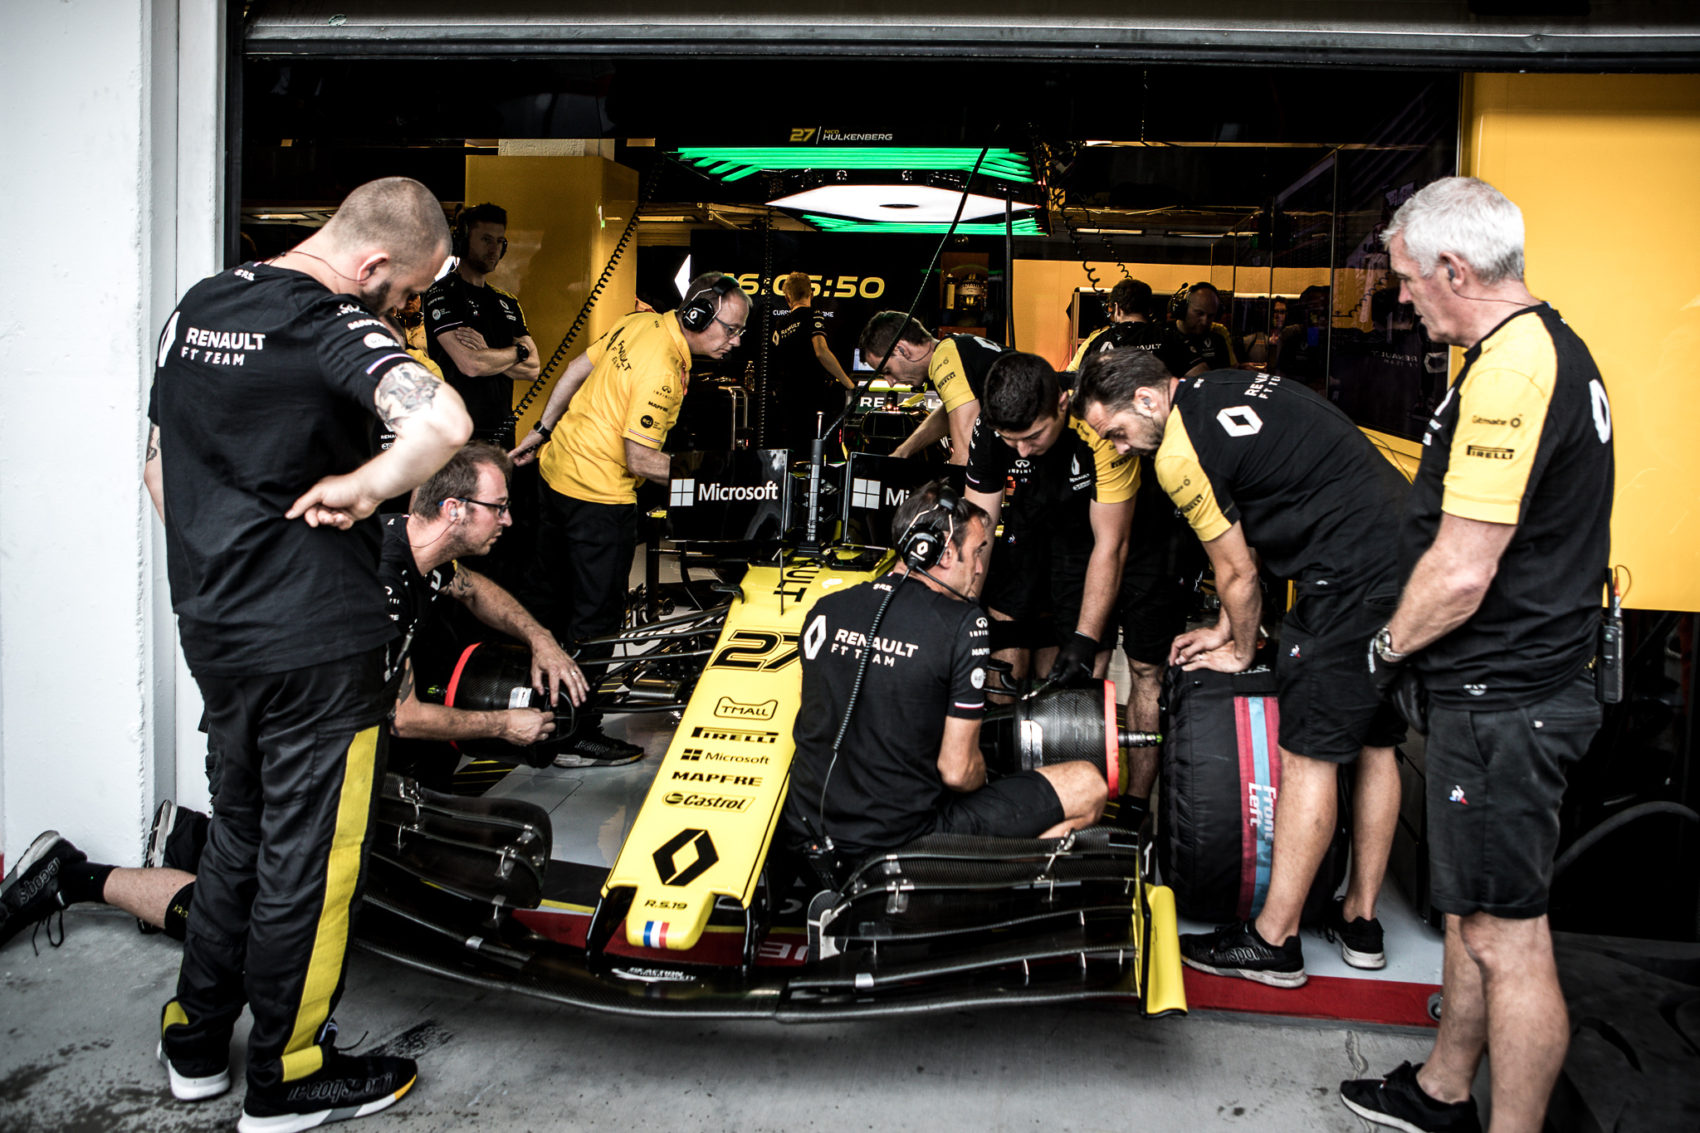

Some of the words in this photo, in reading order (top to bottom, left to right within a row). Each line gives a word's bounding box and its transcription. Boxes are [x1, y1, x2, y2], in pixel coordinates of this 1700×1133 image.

[789, 128, 817, 142] 27
[822, 133, 893, 141] HULKENBERG
[186, 327, 266, 351] RENAULT
[204, 351, 245, 366] TEAM
[1466, 445, 1515, 460] PIRELLI
[698, 480, 779, 501] Microsoft
[705, 629, 801, 674] 27
[834, 628, 919, 659] RENAULT
[721, 705, 769, 717] TMALL
[691, 727, 779, 744] PIRELLI
[705, 752, 770, 765] Microsoft
[671, 771, 763, 787] MAPFRE
[683, 794, 747, 810] Castrol
[1248, 782, 1264, 828] Left
[1263, 785, 1277, 847] Front
[644, 899, 688, 910] R.S.19
